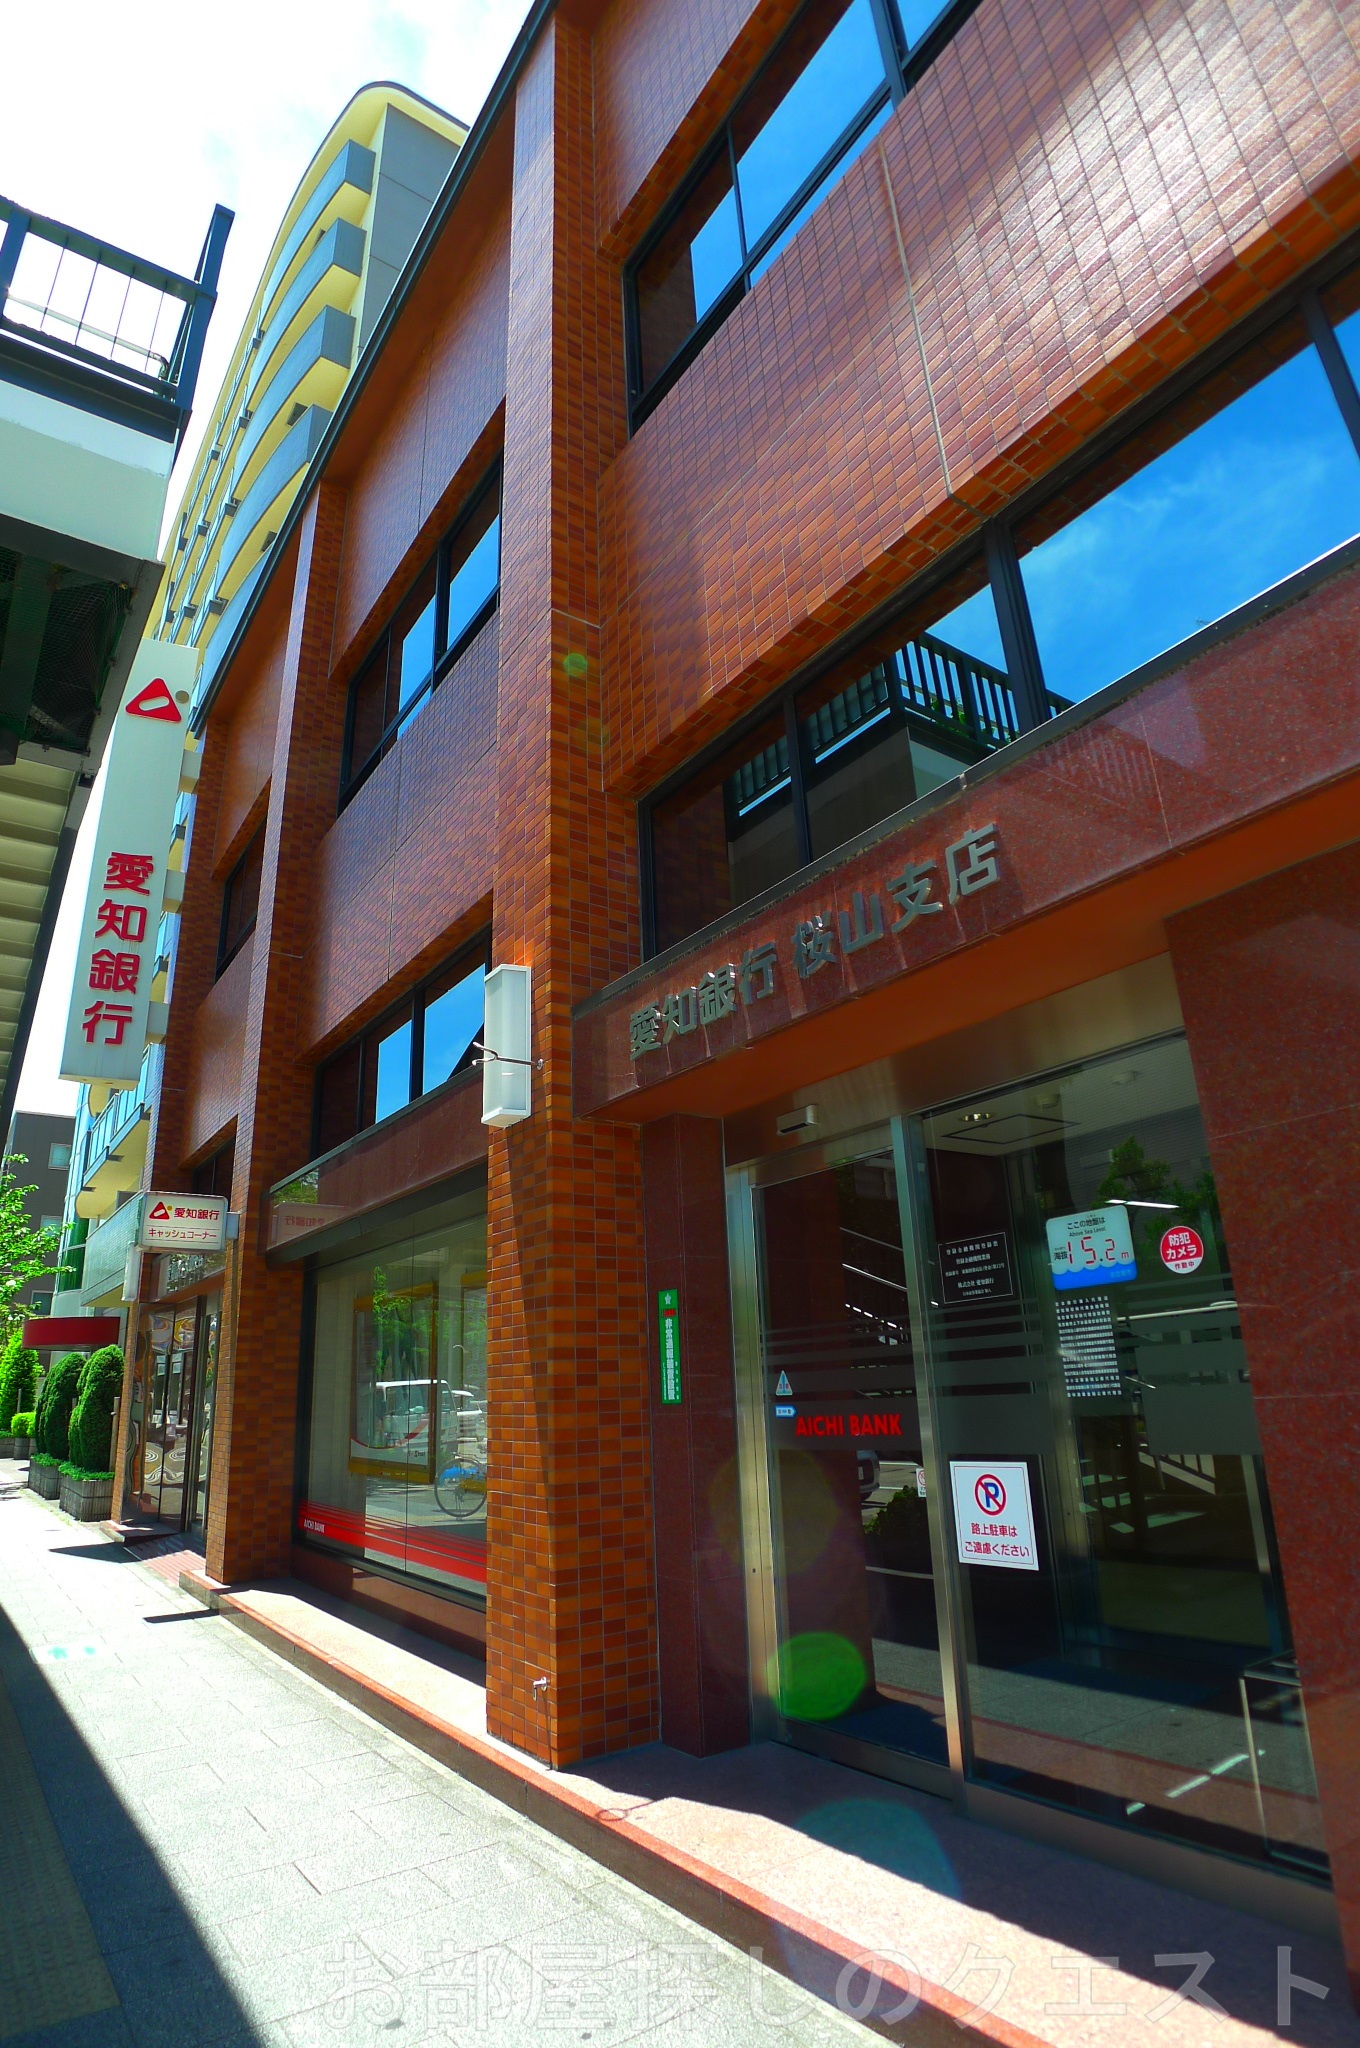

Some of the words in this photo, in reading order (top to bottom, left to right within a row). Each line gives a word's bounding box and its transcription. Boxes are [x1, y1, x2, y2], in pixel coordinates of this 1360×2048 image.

[82, 851, 154, 1046] 愛知銀行
[629, 940, 778, 1061] 愛知銀行
[791, 823, 1003, 979] 桜山支店
[174, 1207, 220, 1221] 愛知銀行
[1067, 1216, 1105, 1230] ここの地盤は
[1093, 1226, 1106, 1234] Level
[148, 1228, 216, 1240] キャッシュコーナー
[1168, 1232, 1191, 1247] 防犯
[1067, 1236, 1116, 1264] 15.2
[1166, 1244, 1197, 1261] カメラ
[1174, 1261, 1195, 1270] 作動中
[795, 1415, 845, 1437] AICHI
[849, 1412, 903, 1437] BANK
[971, 1522, 1018, 1538] 路上駐車は
[964, 1541, 1030, 1557] ご遠慮ください
